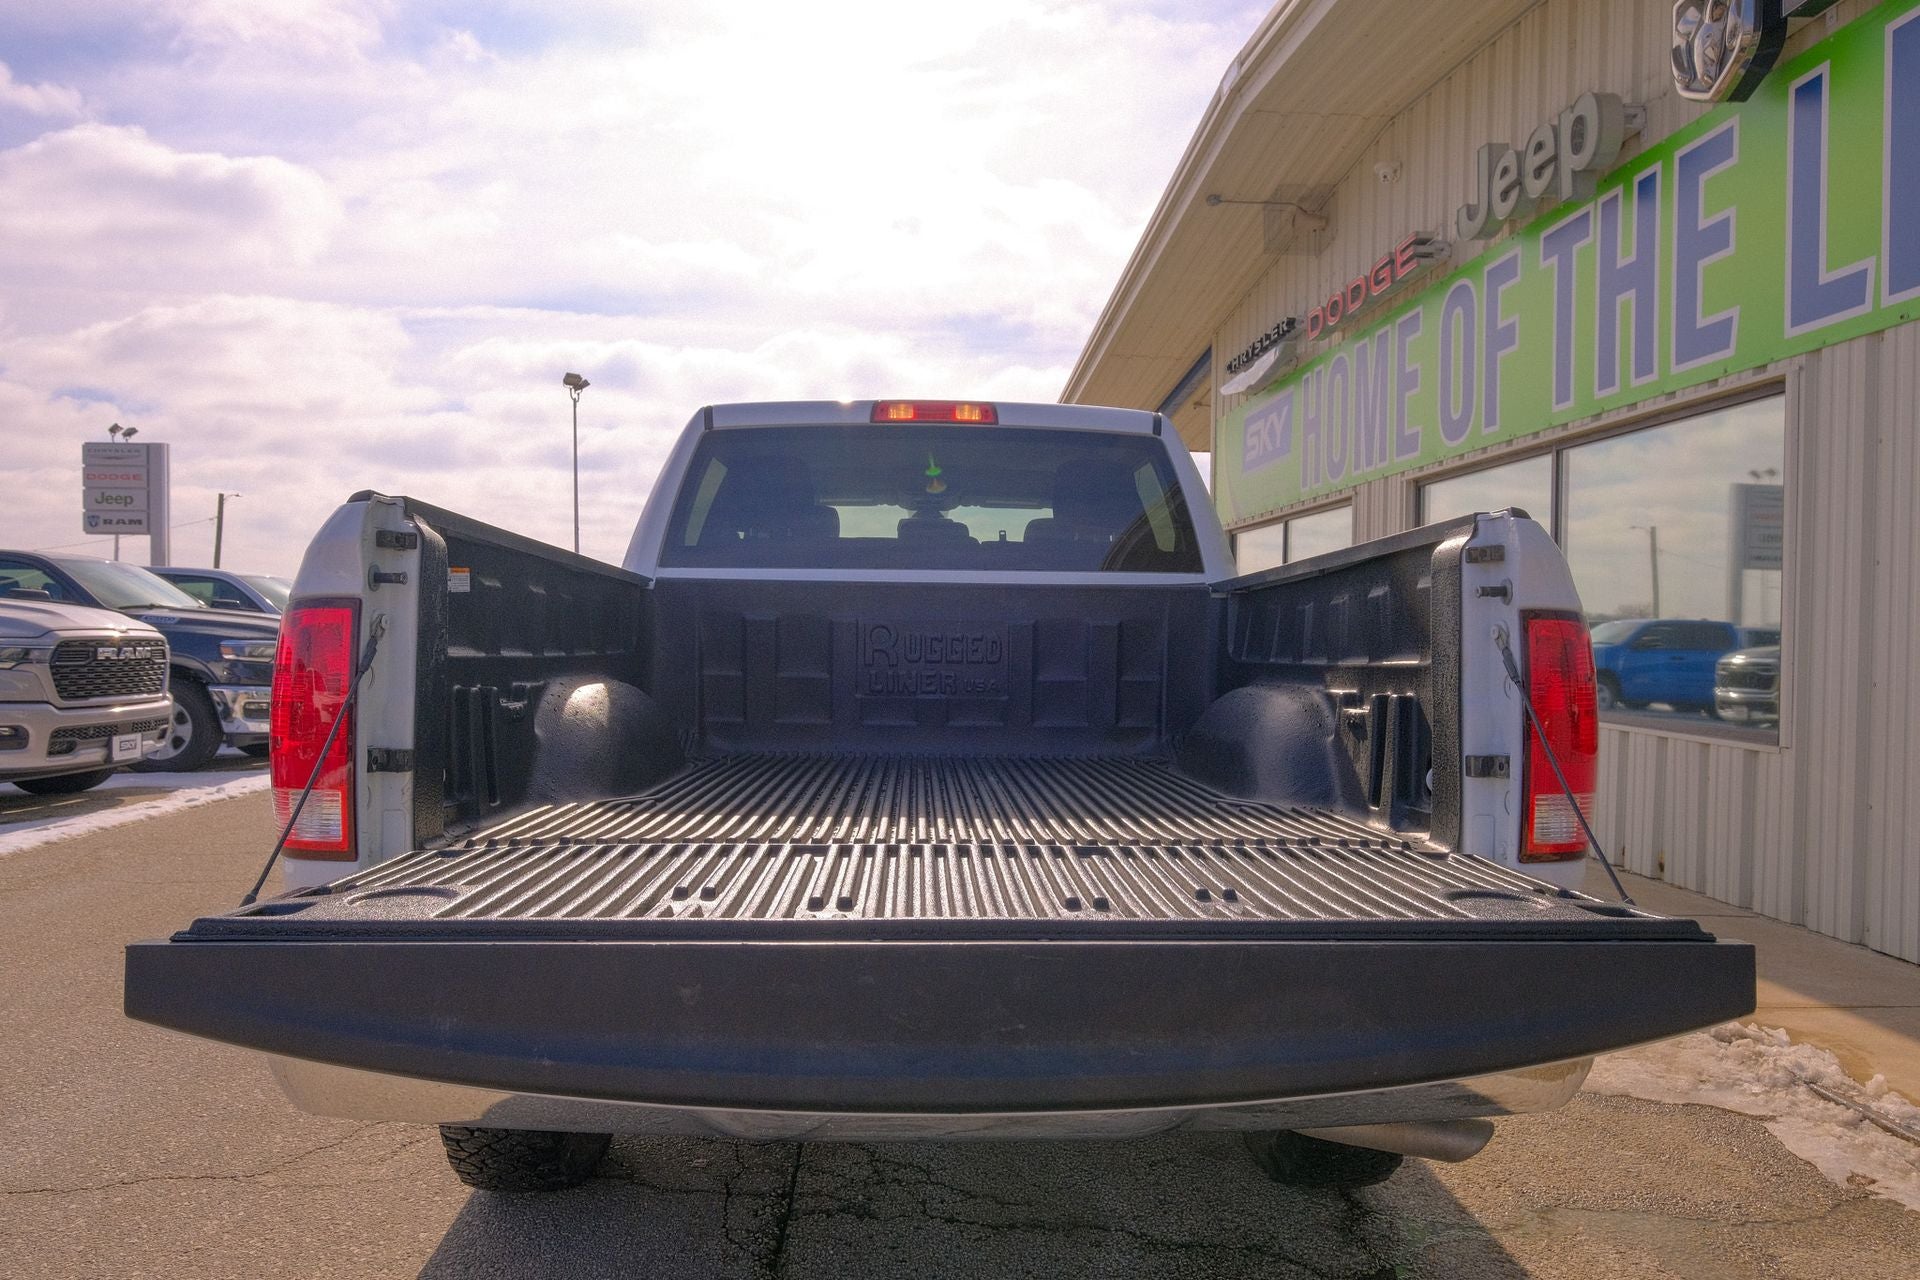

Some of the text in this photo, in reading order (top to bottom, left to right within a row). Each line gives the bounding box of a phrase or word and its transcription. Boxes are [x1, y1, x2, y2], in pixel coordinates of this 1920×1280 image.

[1456, 91, 1624, 241] Jeep
[1306, 231, 1420, 341] DODGE
[1301, 304, 1424, 491] HOME
[1438, 246, 1521, 448] OF
[1539, 112, 1740, 413] THE
[1245, 404, 1289, 462] SKY
[86, 473, 143, 481] DODGE
[94, 492, 134, 507] Jeep
[97, 647, 151, 660] RAM
[868, 671, 959, 695] LINER
[120, 739, 137, 751] SKY
